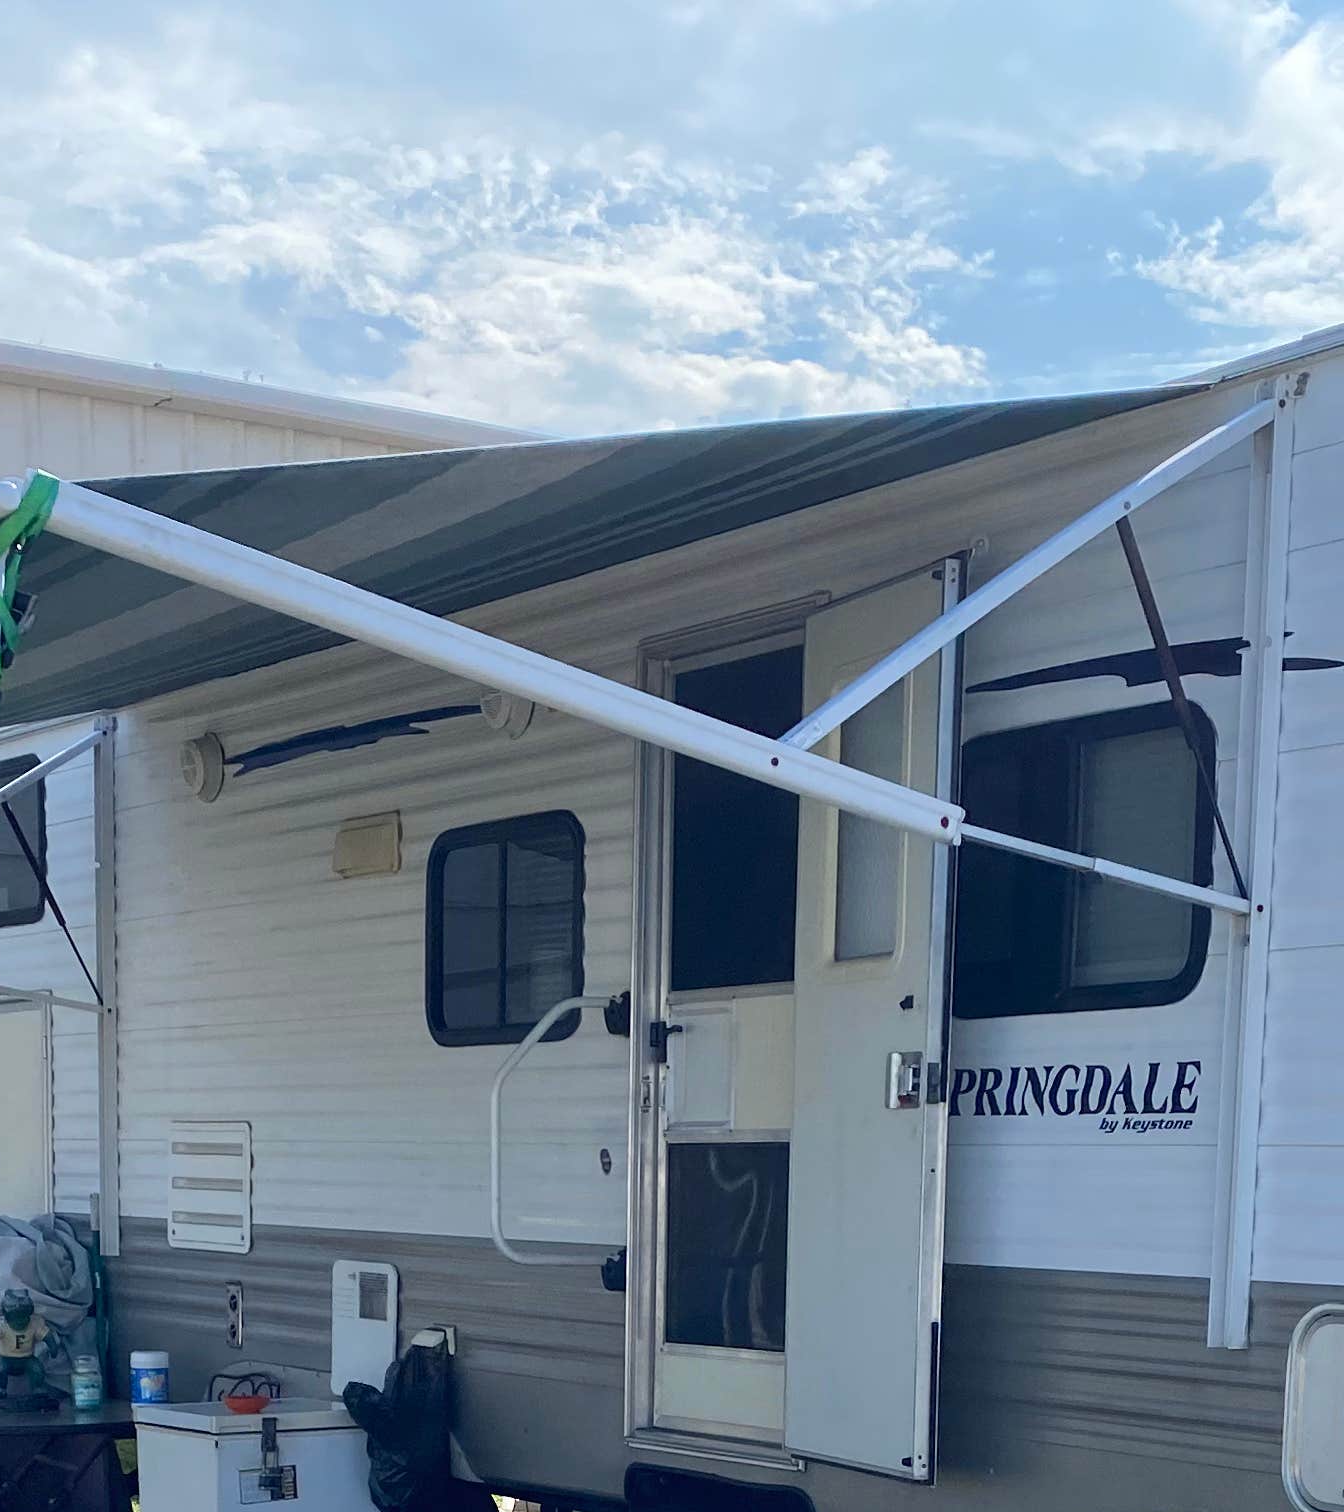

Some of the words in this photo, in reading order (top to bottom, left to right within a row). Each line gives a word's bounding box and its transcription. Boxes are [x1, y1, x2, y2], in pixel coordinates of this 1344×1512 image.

[948, 1061, 1202, 1116] PRINGDALE
[1099, 1117, 1119, 1134] by
[1122, 1117, 1193, 1134] Keystone
